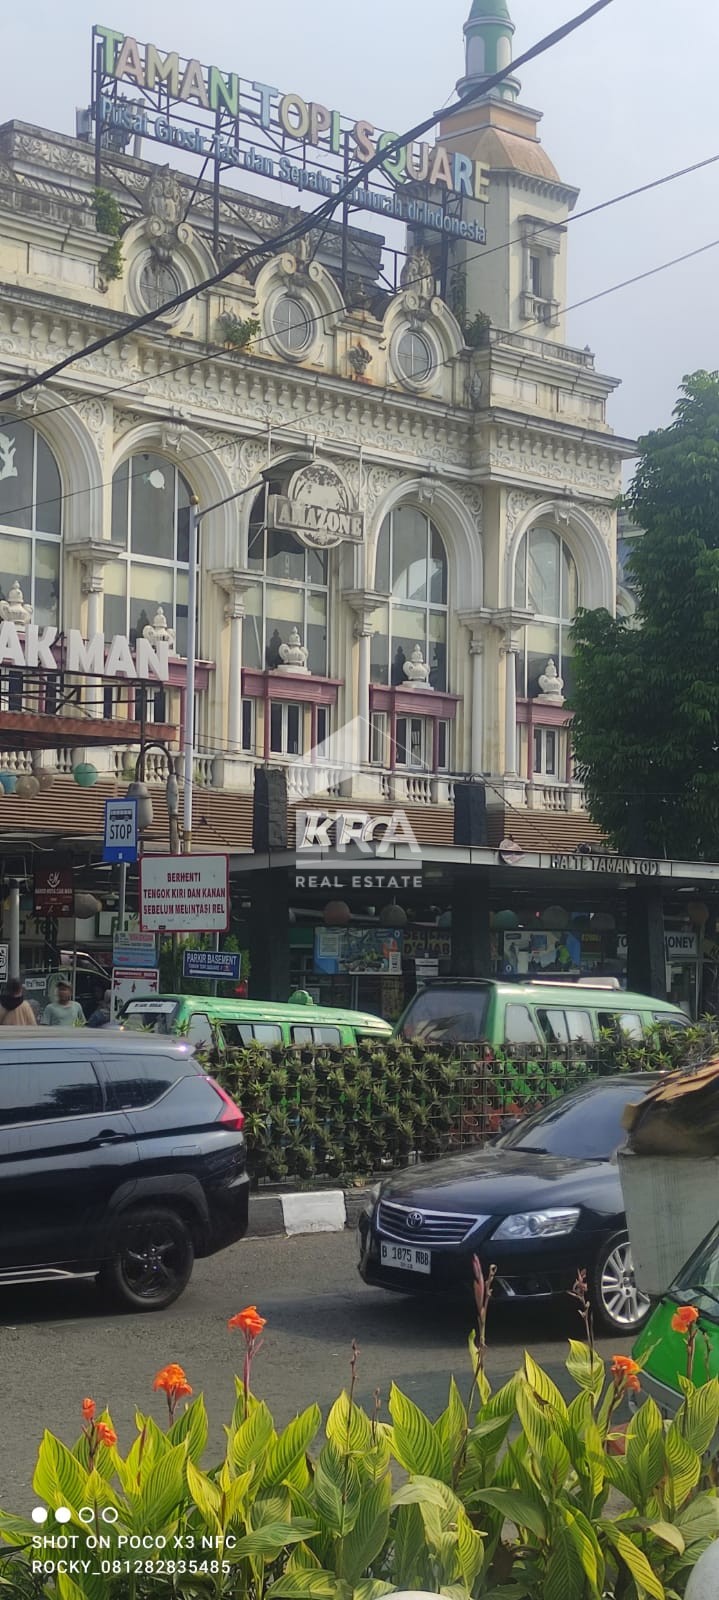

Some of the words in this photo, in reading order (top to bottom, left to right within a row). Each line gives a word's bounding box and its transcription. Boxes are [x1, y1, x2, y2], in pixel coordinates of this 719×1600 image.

[94, 25, 240, 117] TAMAN
[252, 81, 341, 152] TOPI
[352, 120, 490, 203] SQUARE
[99, 96, 148, 136] Pusat
[154, 116, 206, 152] Grosir
[212, 133, 239, 165] Tas
[245, 147, 274, 177] dan
[279, 157, 332, 193] Sepatu
[422, 204, 487, 243] Indonesia
[66, 629, 169, 681] MAN
[110, 824, 132, 839] STOP
[551, 855, 589, 870] HALTE
[591, 857, 630, 874] TAMAN
[167, 872, 201, 882] BERHENTI
[143, 888, 170, 899] TENGOK
[171, 888, 186, 898] KIRI
[187, 888, 201, 898] DAN
[202, 887, 226, 898] KANAN
[143, 904, 174, 915] SEBELUM
[175, 904, 211, 914] MELINTASI
[212, 904, 225, 914] REL
[186, 953, 207, 964] PARKIR
[207, 954, 237, 967] BASEMENT
[382, 1245, 388, 1258] B
